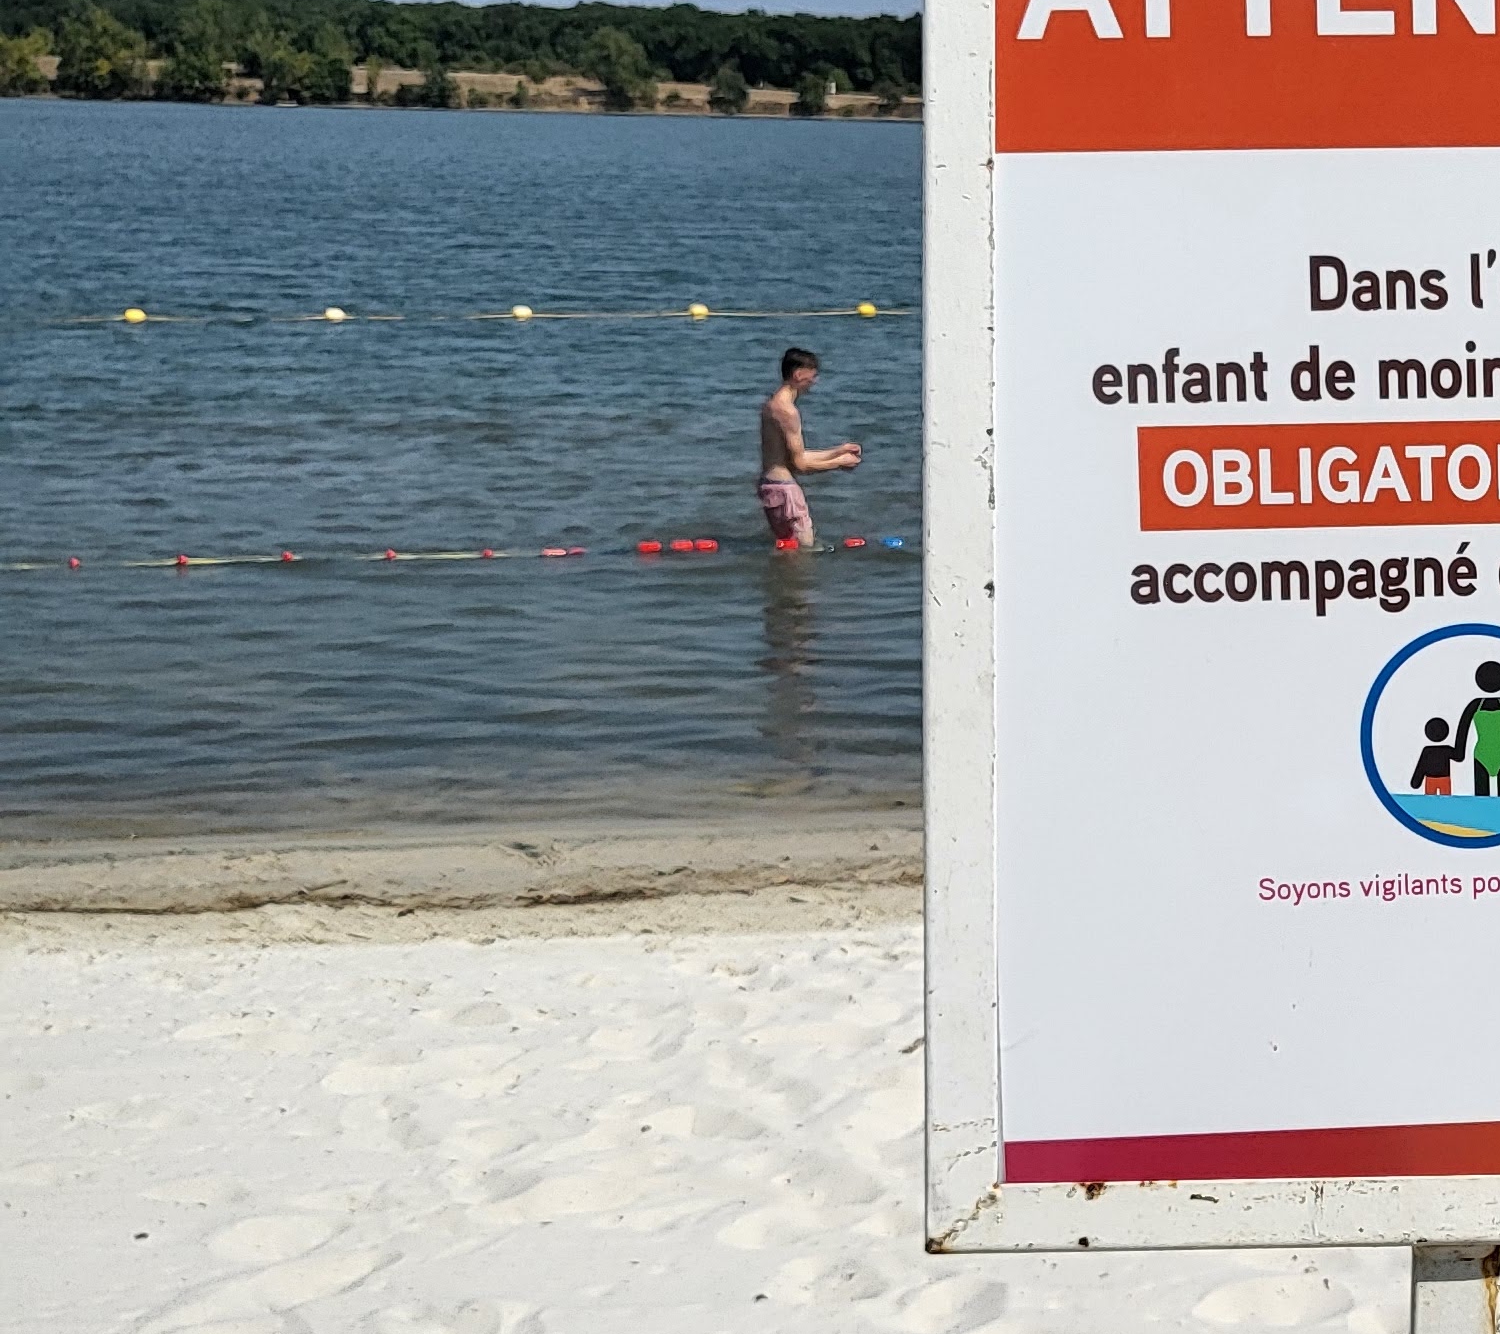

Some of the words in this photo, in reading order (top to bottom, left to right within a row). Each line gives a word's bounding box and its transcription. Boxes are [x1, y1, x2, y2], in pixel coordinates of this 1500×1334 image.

[1309, 255, 1448, 312] Dans
[1091, 347, 1268, 405] enfant
[1290, 345, 1356, 401] de
[1130, 542, 1478, 617] accompagné
[1258, 878, 1352, 906] Soyons
[1359, 873, 1463, 902] vigilants
